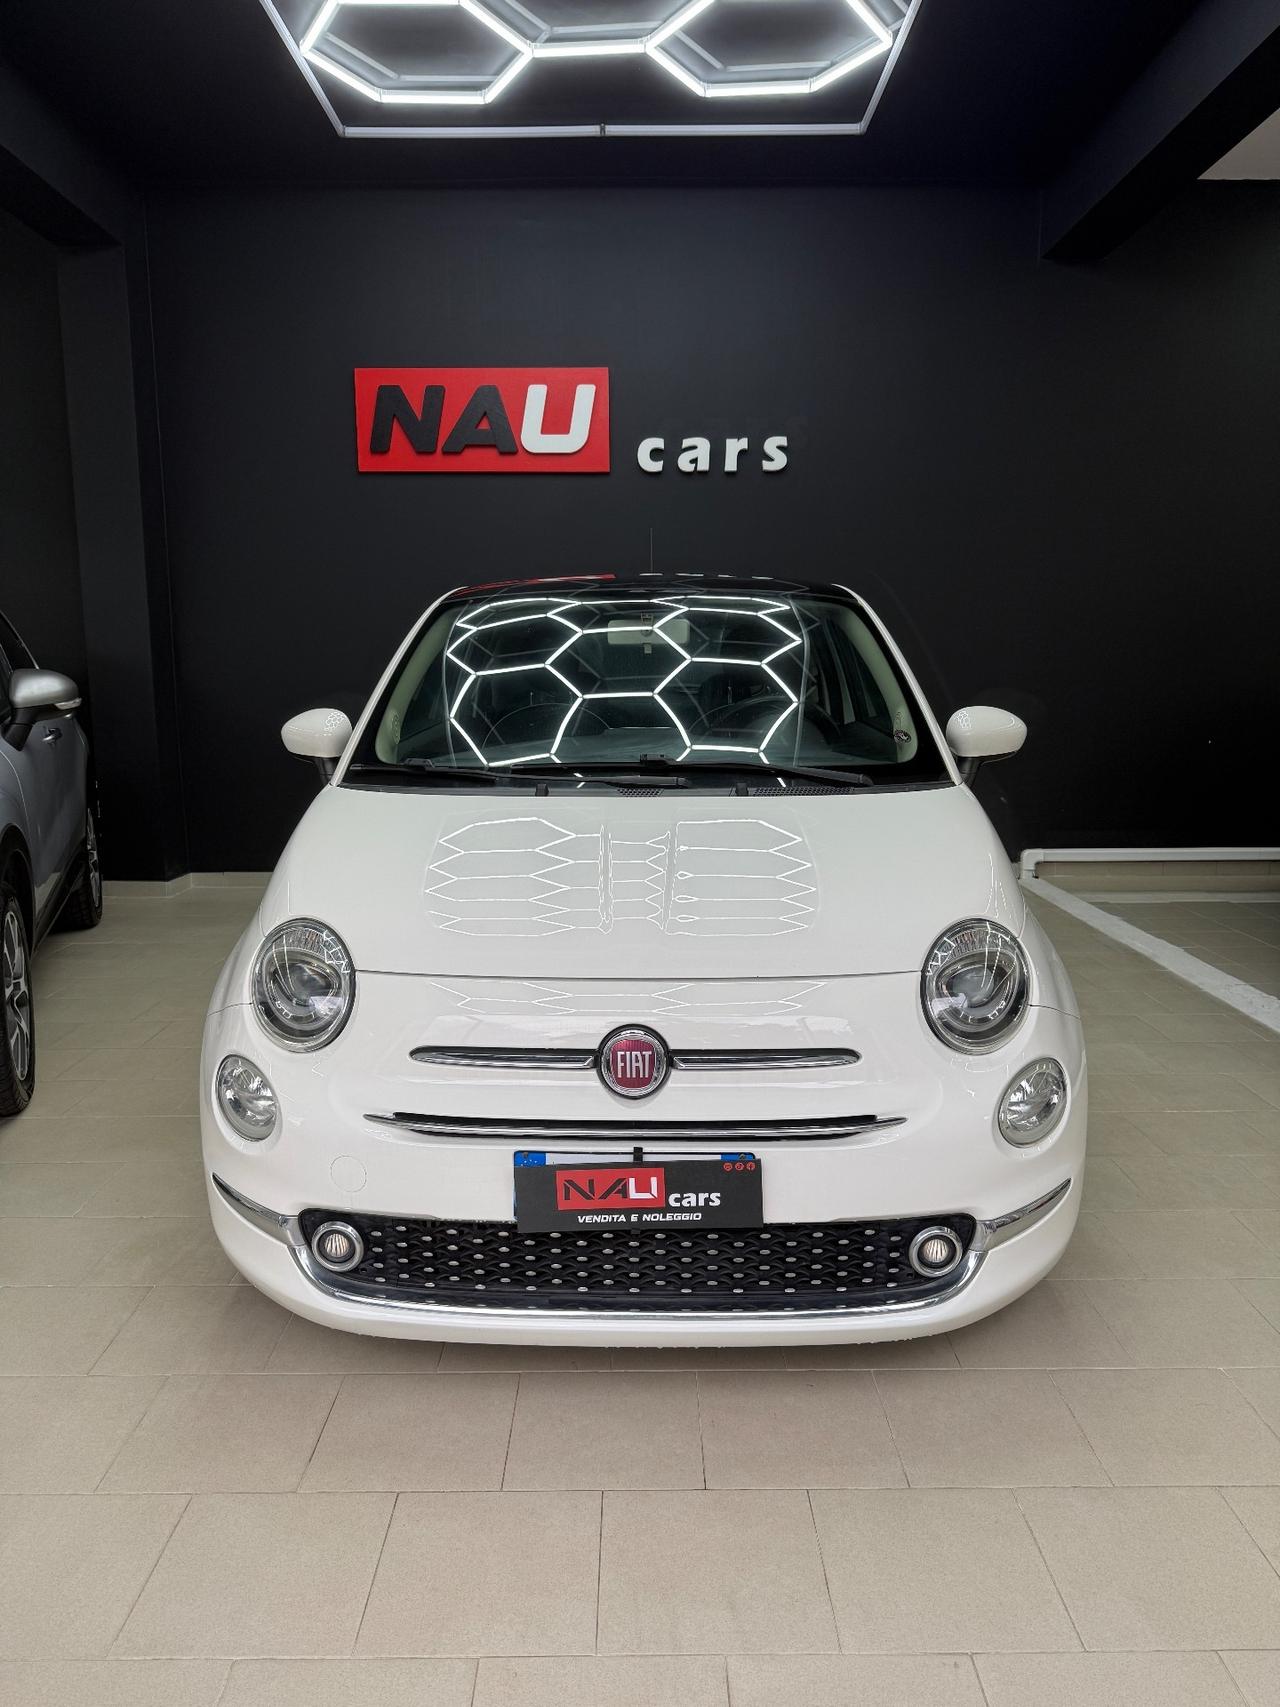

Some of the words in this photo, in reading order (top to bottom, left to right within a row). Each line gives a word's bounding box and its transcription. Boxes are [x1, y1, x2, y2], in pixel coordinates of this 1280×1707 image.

[370, 384, 596, 454] NAU
[637, 436, 788, 473] cars
[617, 1051, 652, 1078] FIAT
[563, 1177, 657, 1200] NAU
[668, 1192, 721, 1207] cars
[577, 1214, 626, 1223] VENDITA
[630, 1213, 638, 1222] E
[642, 1212, 702, 1222] NOLEGGIO
